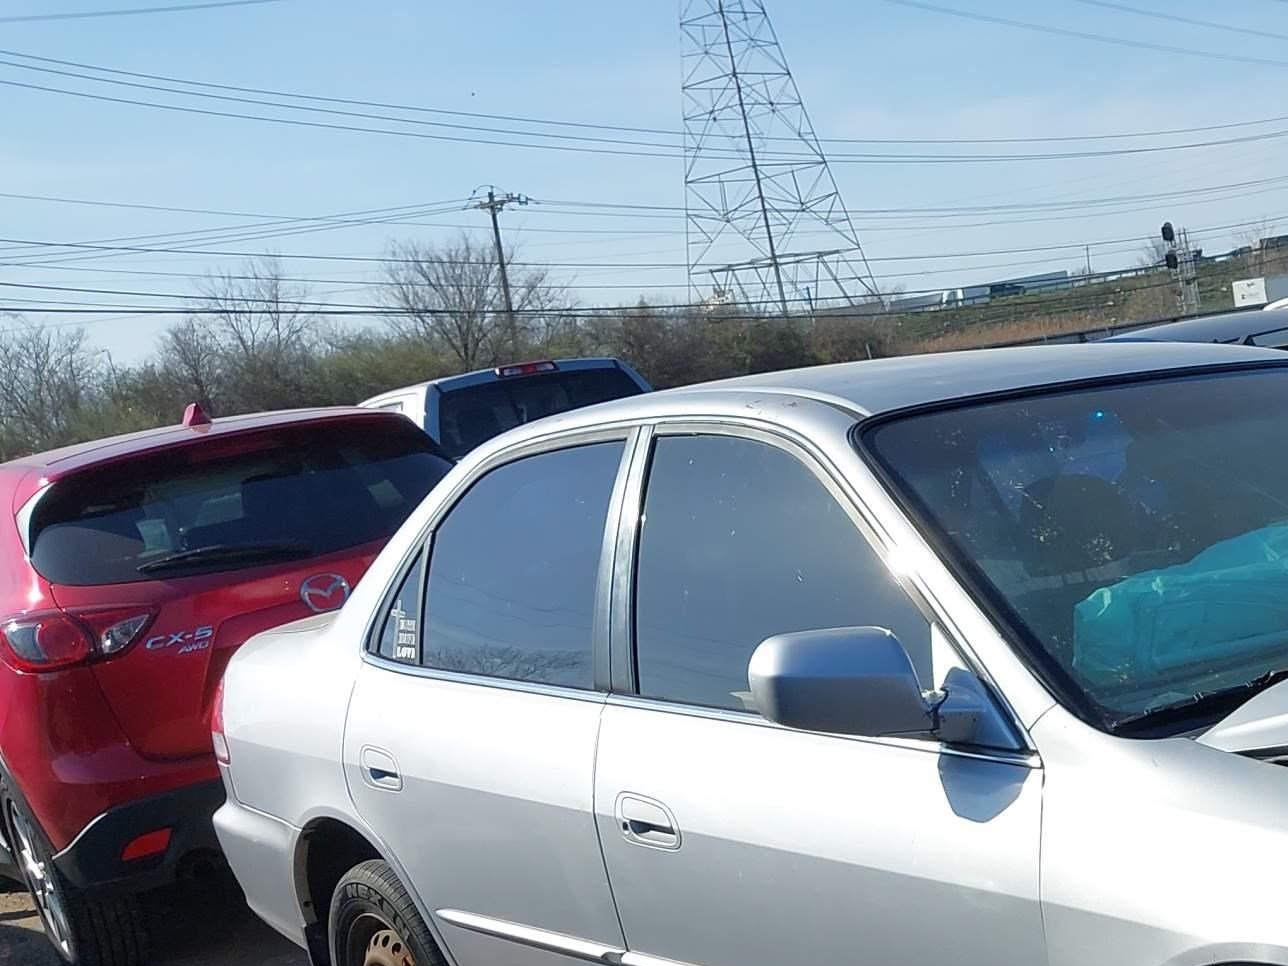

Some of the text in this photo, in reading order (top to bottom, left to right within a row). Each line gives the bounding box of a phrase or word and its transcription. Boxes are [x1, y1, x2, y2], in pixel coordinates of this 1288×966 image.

[146, 625, 213, 649] CX-5
[178, 640, 209, 655] AWD
[345, 883, 411, 943] NEXEN
